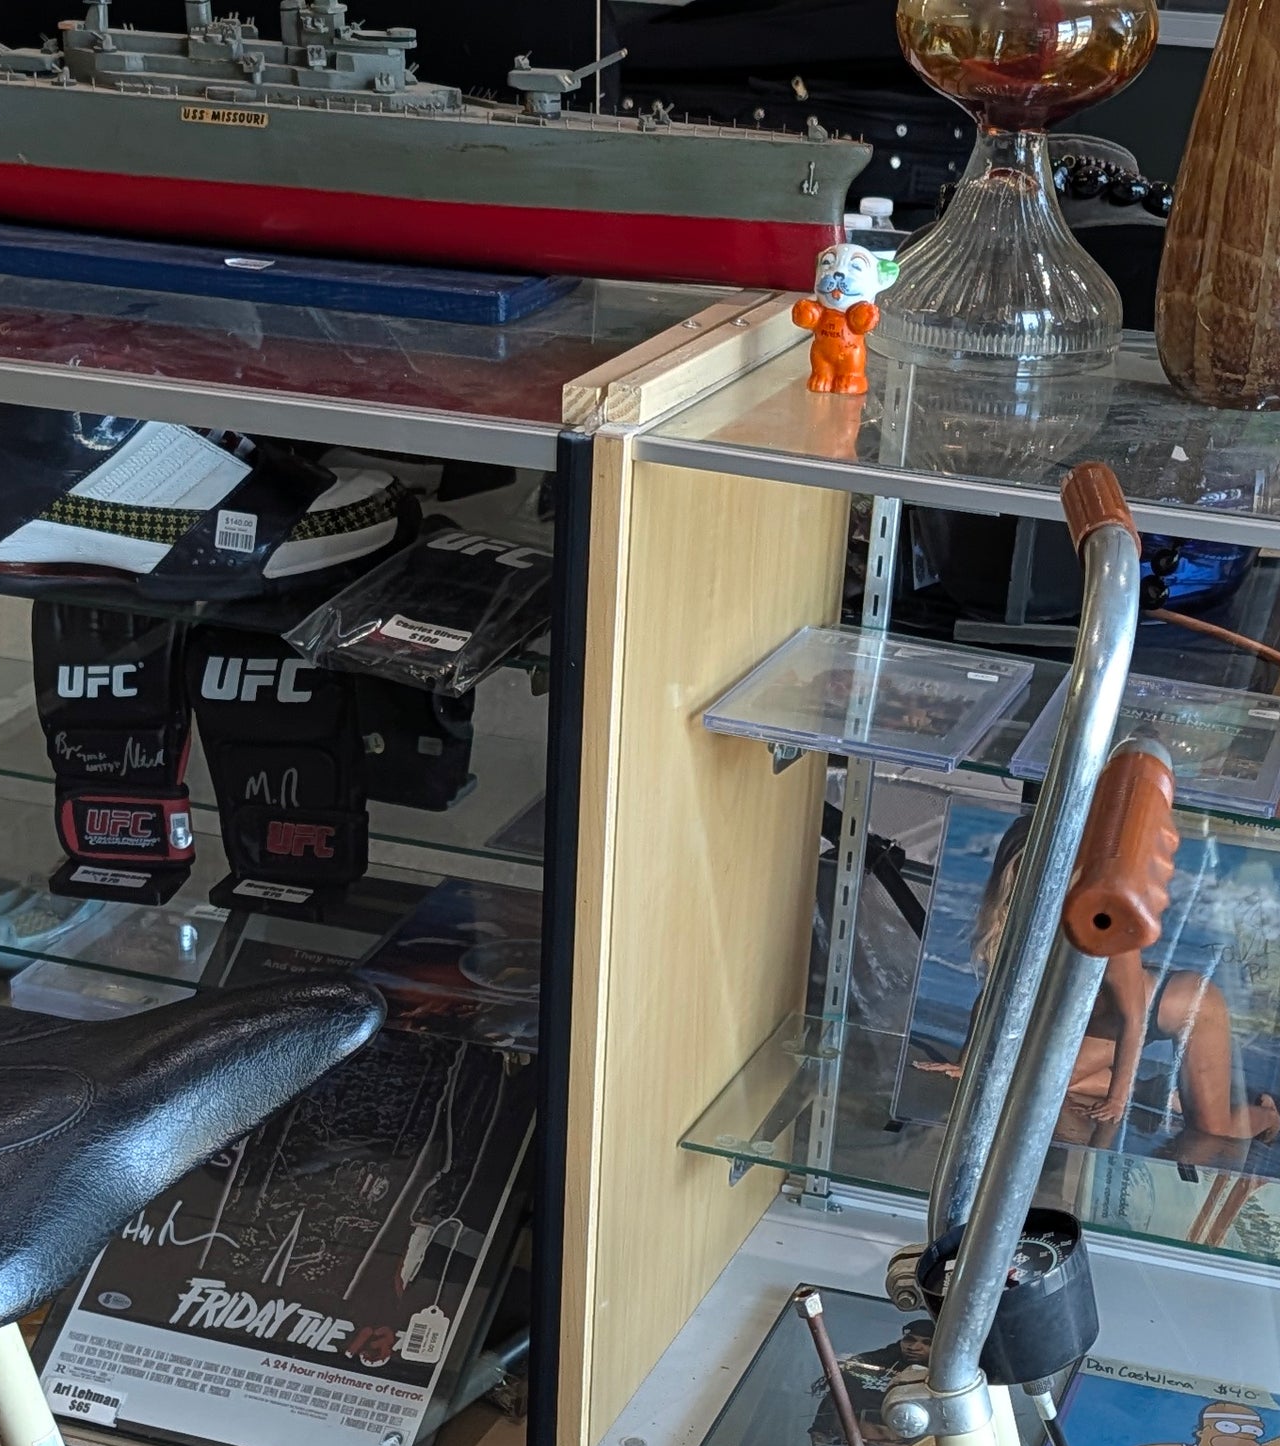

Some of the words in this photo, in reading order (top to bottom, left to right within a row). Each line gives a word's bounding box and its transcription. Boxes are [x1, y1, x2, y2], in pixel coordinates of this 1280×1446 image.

[182, 107, 206, 121] USS
[210, 110, 266, 125] MISSOURI
[224, 516, 254, 528] $140.00
[426, 532, 554, 569] UFC
[395, 619, 434, 634] Charles
[408, 632, 440, 645] $100
[57, 663, 138, 699] UFC
[200, 655, 316, 703] UFC
[85, 808, 154, 838] UFC
[266, 820, 336, 859] UFC
[168, 1277, 302, 1342] FRIDAY
[287, 1308, 356, 1353] THE
[53, 1363, 67, 1374] R
[260, 1357, 271, 1368] A
[272, 1359, 288, 1372] 24
[289, 1362, 316, 1378] hour
[316, 1371, 374, 1391] nightmare
[375, 1384, 388, 1395] of
[390, 1387, 424, 1402] terror.
[1085, 1358, 1114, 1376] Dan
[1212, 1383, 1258, 1400] $40
[53, 1382, 72, 1396] Ari
[71, 1386, 121, 1408] Lehman
[68, 1399, 92, 1414] $65
